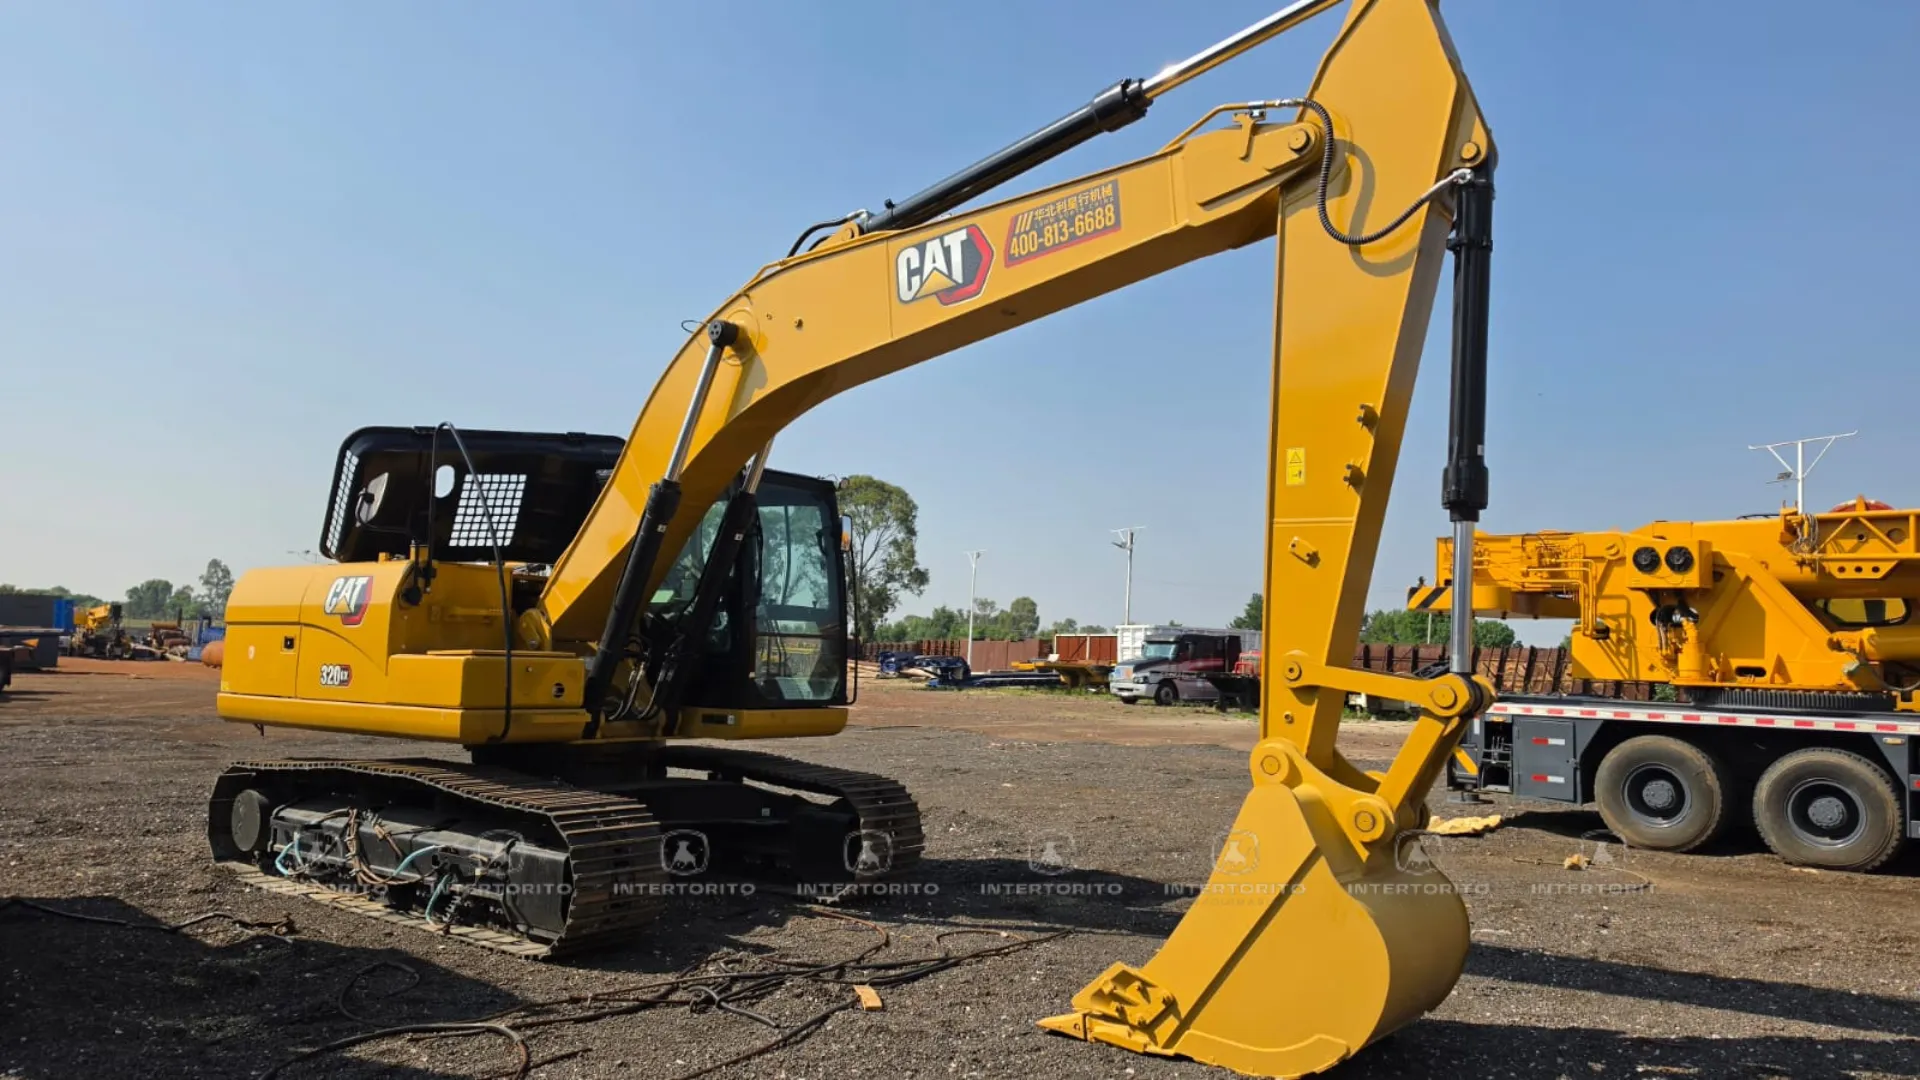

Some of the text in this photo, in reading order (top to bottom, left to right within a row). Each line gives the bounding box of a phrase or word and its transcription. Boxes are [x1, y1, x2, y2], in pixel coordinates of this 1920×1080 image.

[1010, 204, 1115, 257] 400-813-6688
[897, 228, 968, 301] CAT
[324, 577, 370, 614] CAT
[320, 665, 341, 685] 320
